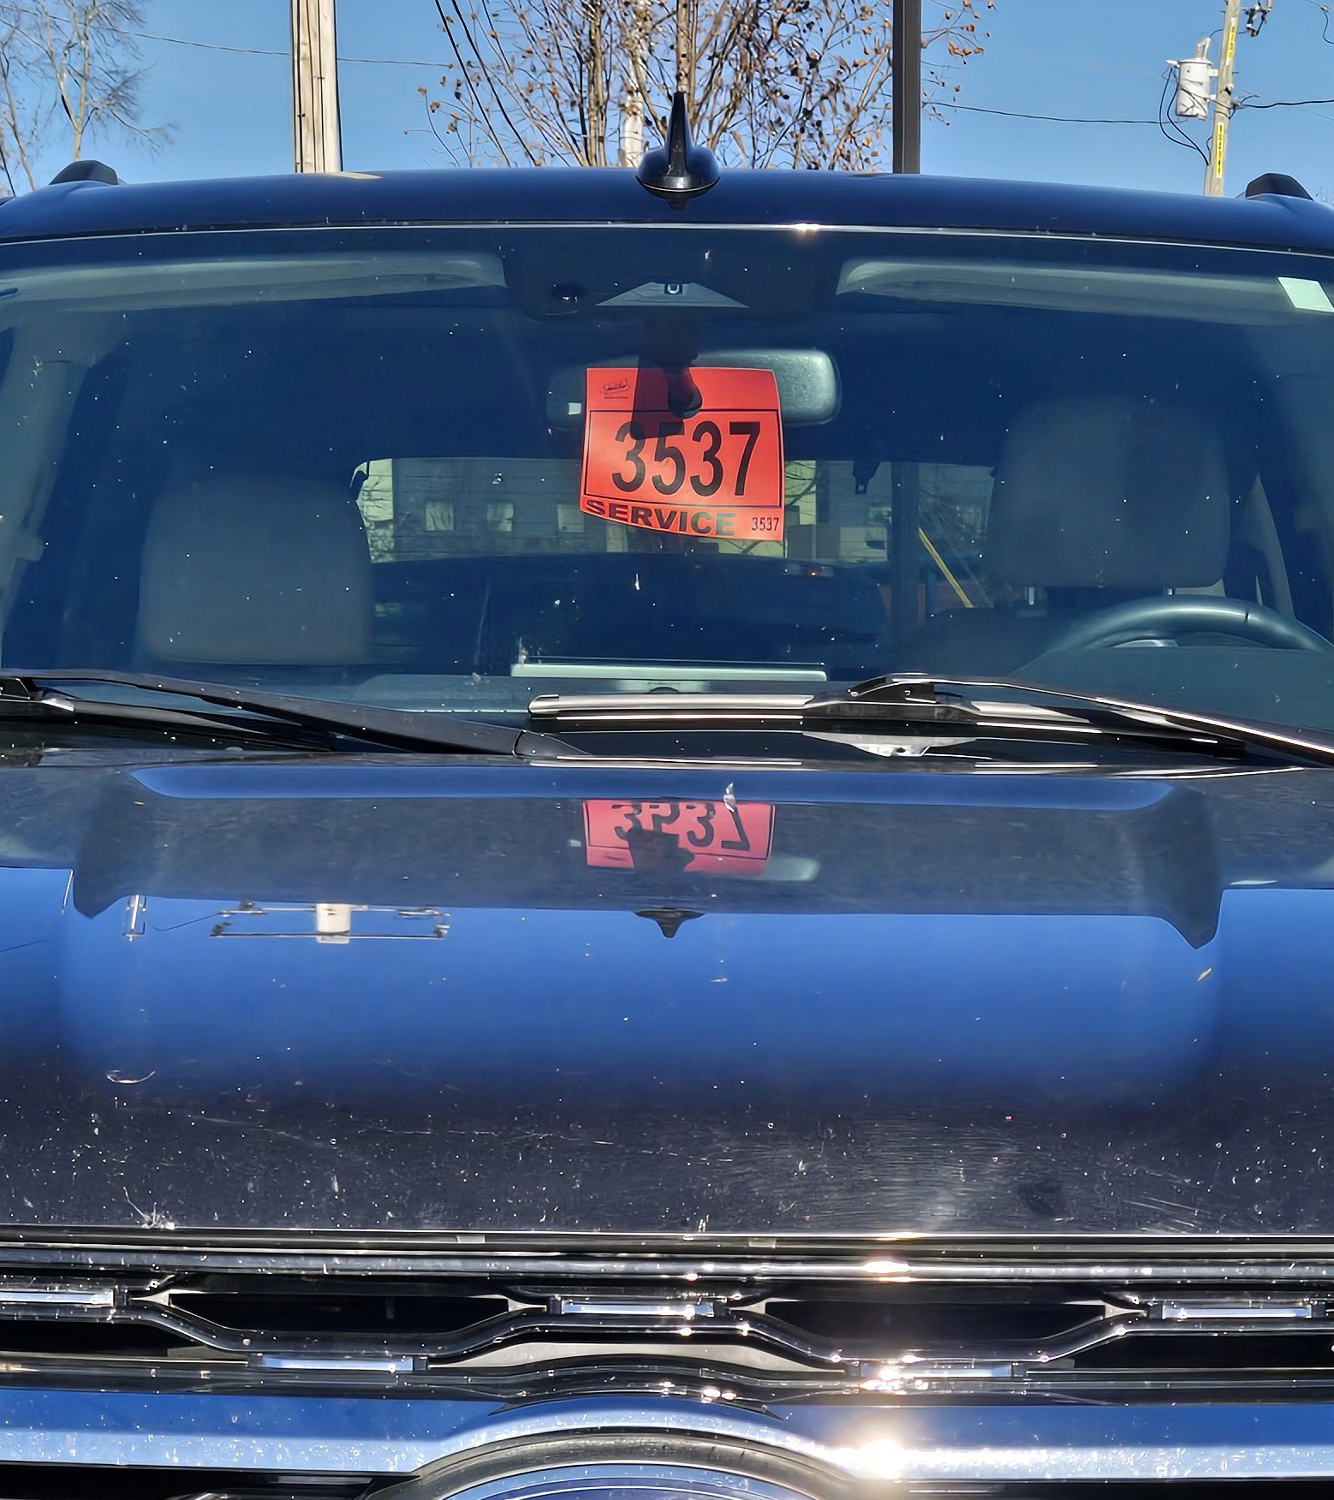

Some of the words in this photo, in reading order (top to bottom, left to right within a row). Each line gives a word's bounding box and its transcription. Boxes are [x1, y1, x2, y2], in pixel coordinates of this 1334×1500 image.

[611, 421, 761, 496] 3537
[585, 499, 736, 536] SERVICE
[751, 517, 780, 532] 3537
